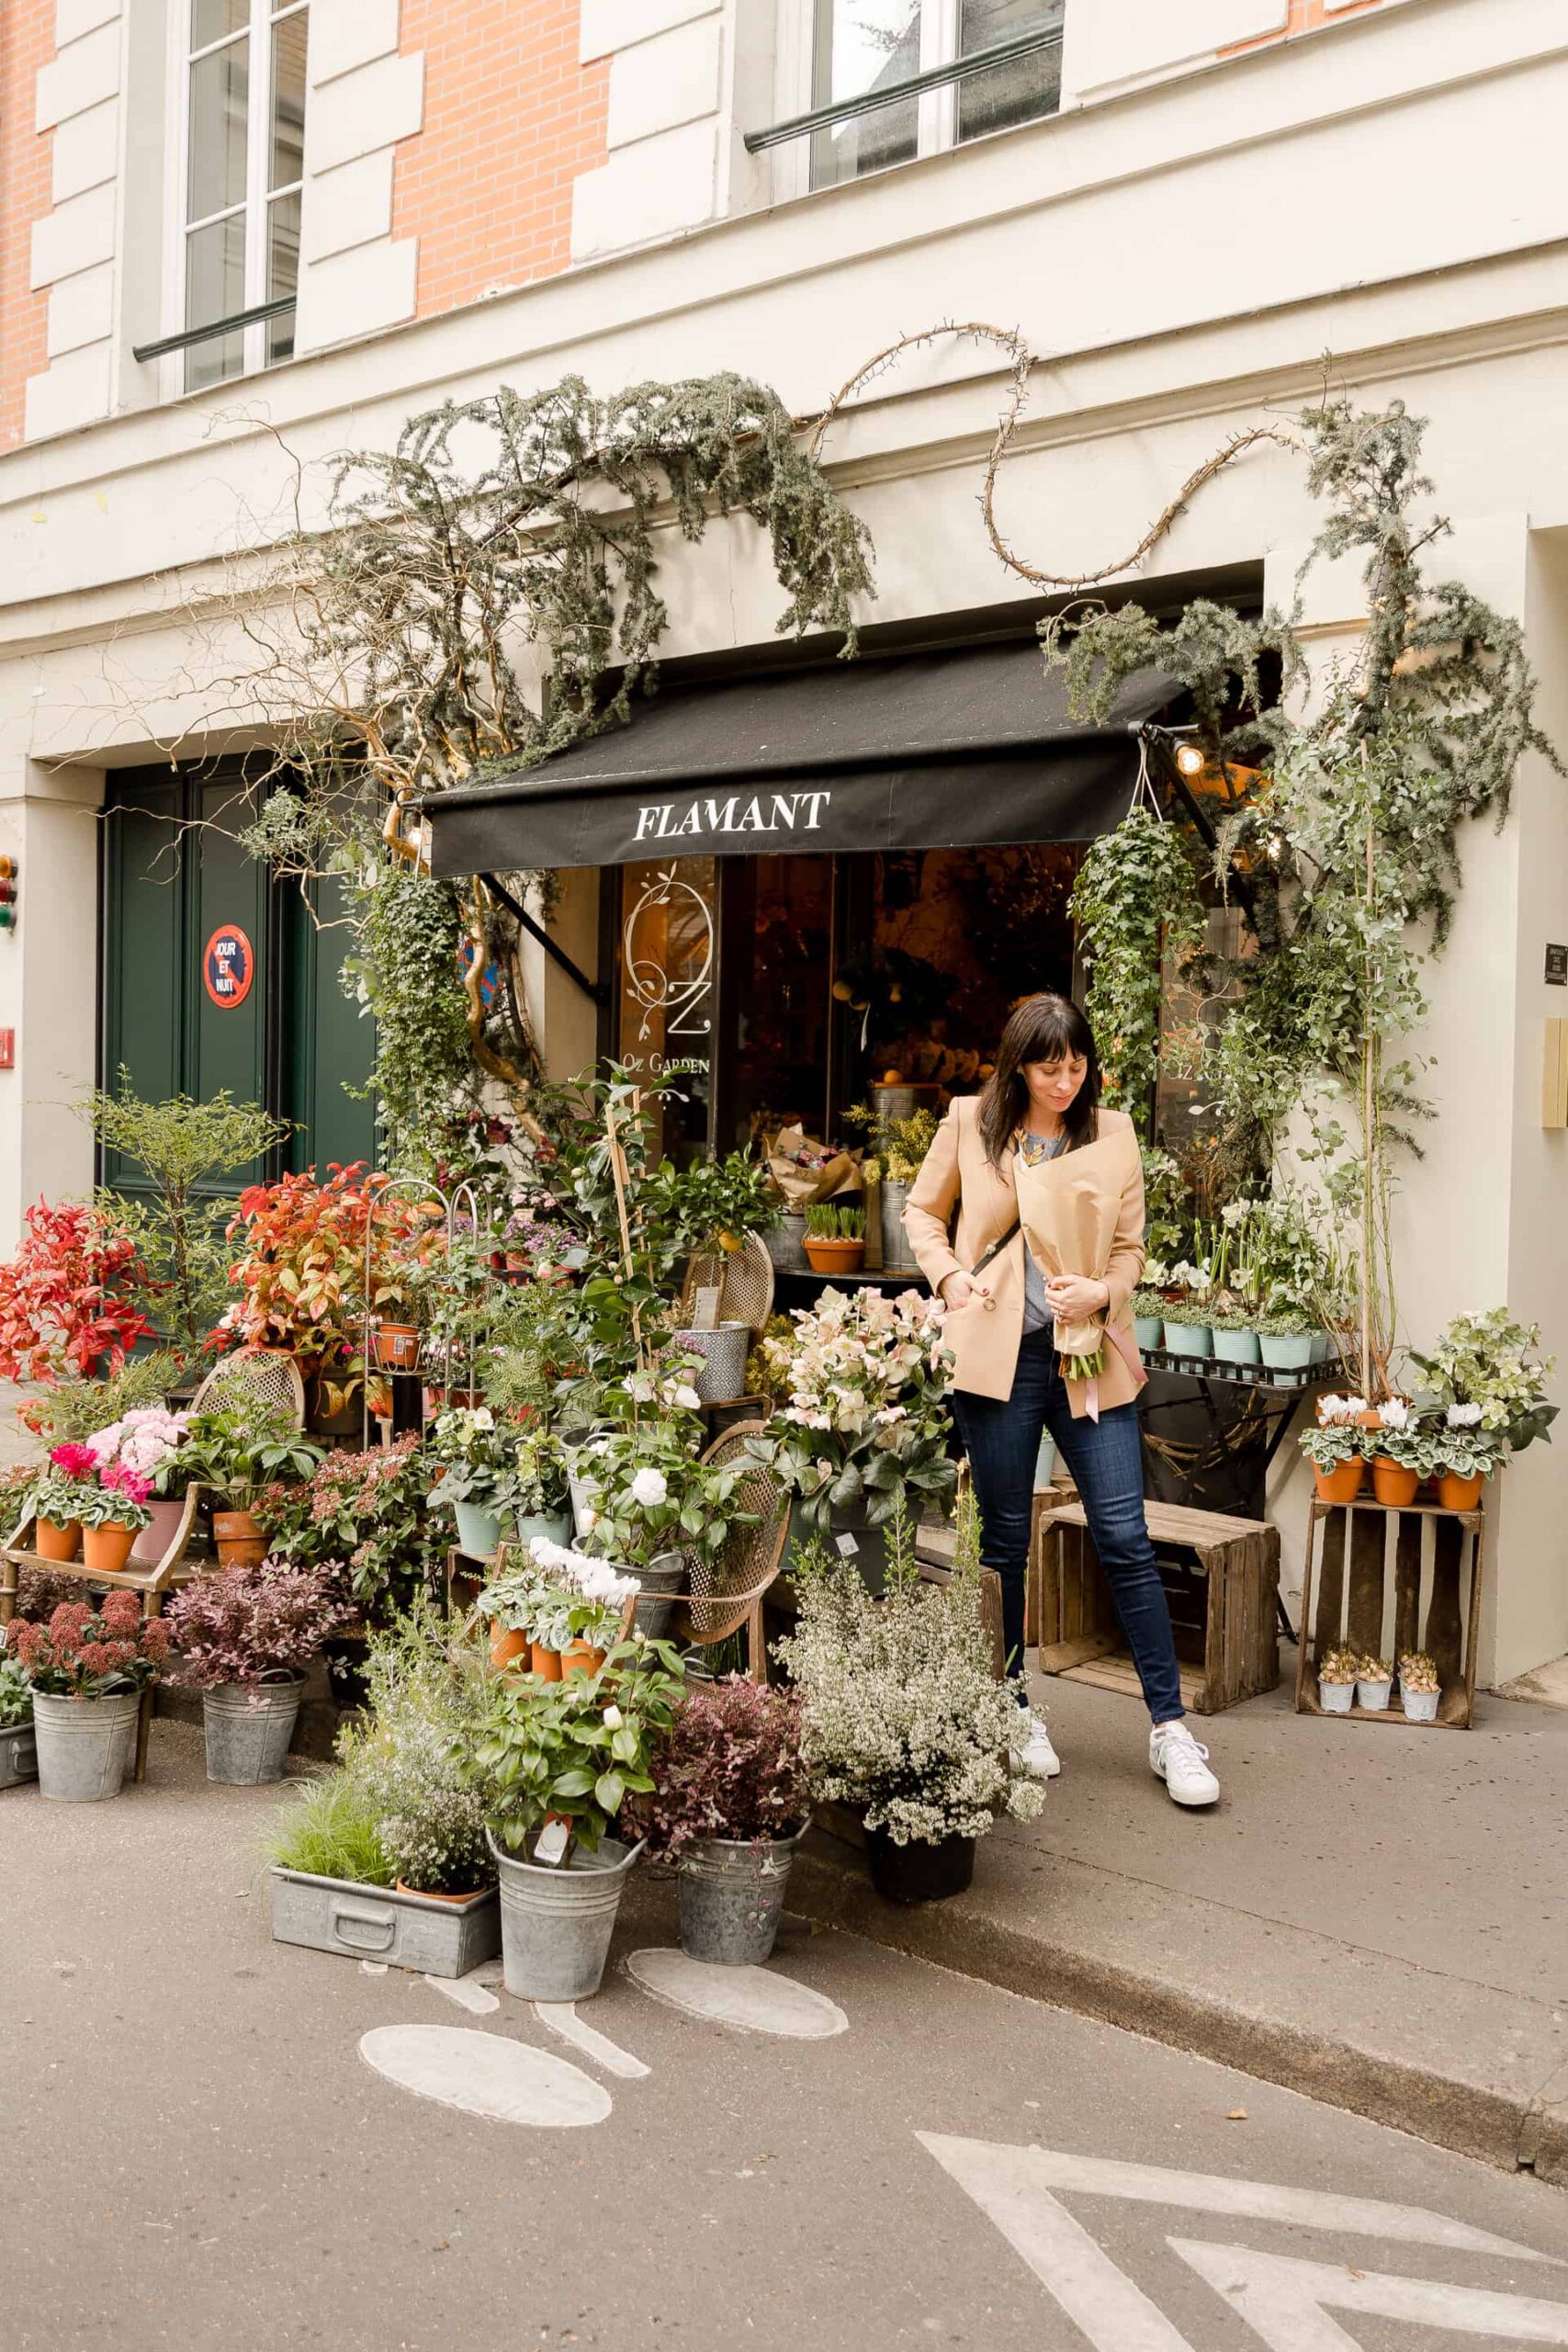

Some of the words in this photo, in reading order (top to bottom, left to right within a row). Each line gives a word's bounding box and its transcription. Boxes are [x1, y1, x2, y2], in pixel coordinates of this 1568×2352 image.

[632, 791, 830, 841] FLAMANT
[214, 942, 236, 956] JOUR
[219, 959, 230, 974] ET
[215, 978, 233, 992] NUIT
[649, 1052, 710, 1074] GARDEN
